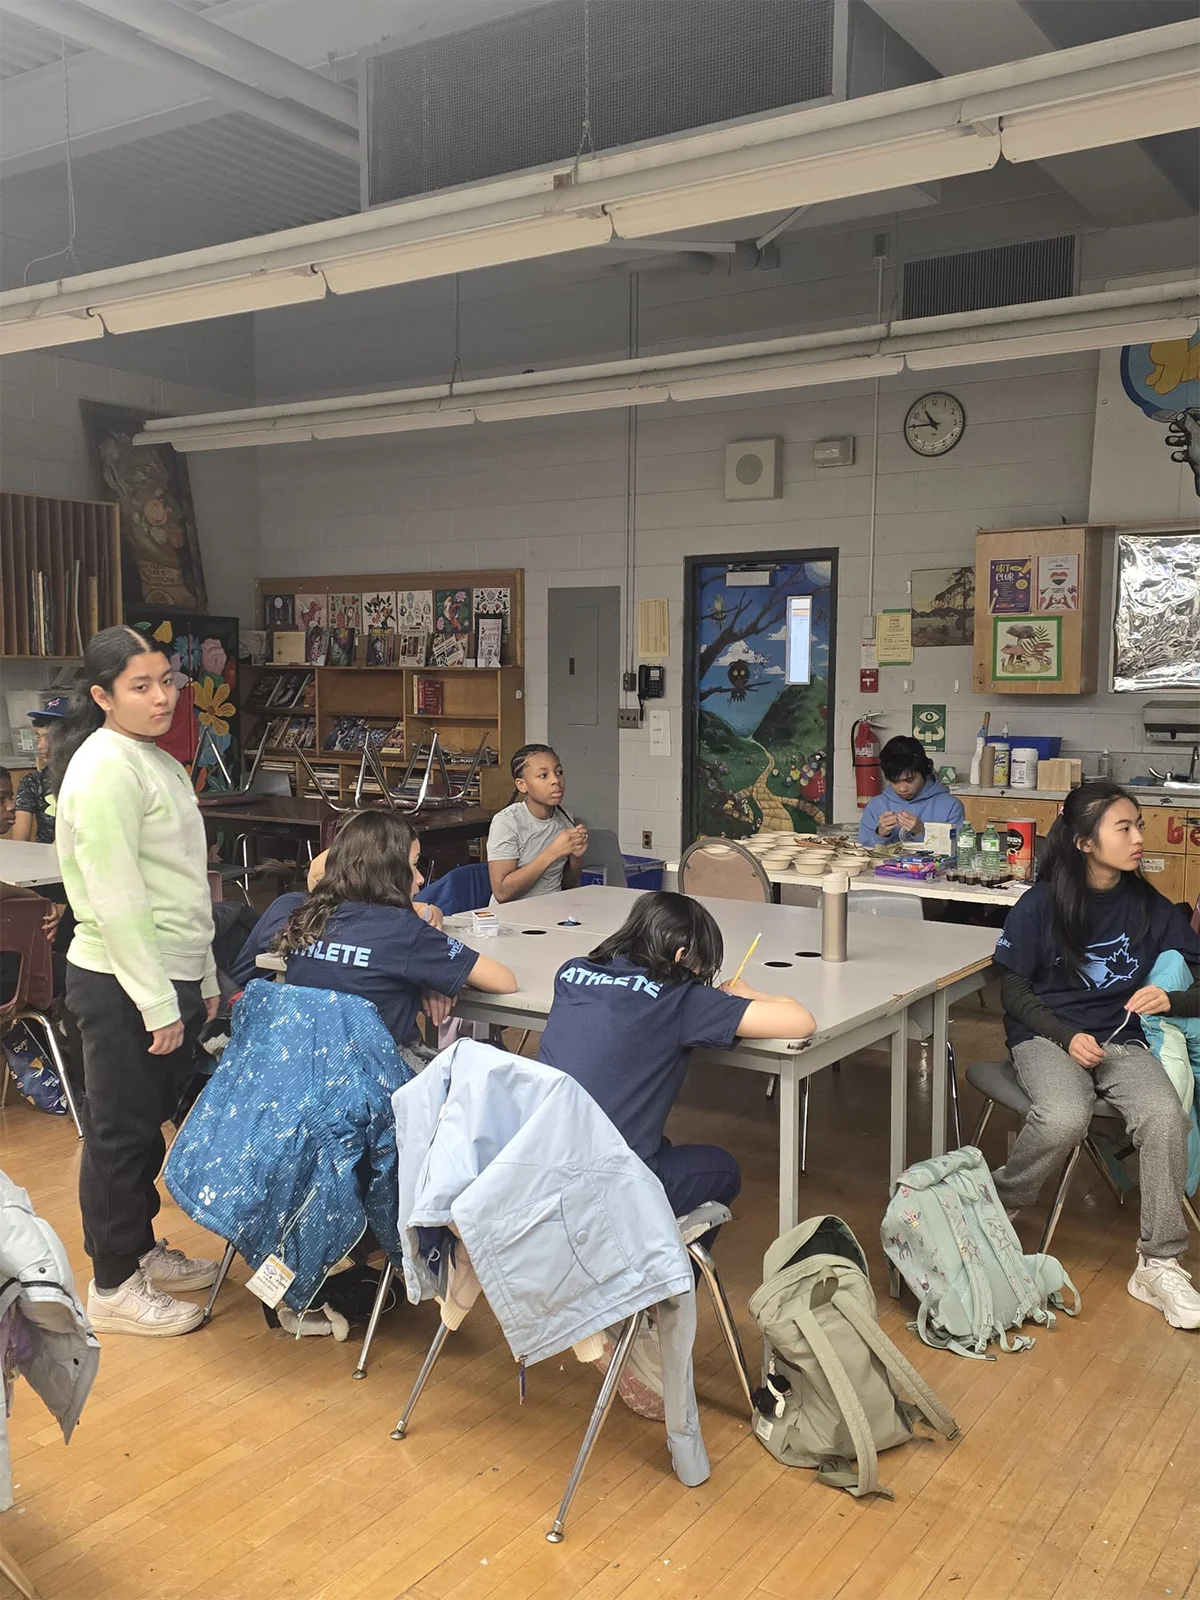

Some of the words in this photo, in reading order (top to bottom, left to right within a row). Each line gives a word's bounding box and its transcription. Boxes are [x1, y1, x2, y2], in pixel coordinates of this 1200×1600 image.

[995, 564, 1011, 573] ART
[996, 572, 1014, 582] CLUB
[560, 967, 664, 999] ATHLETE
